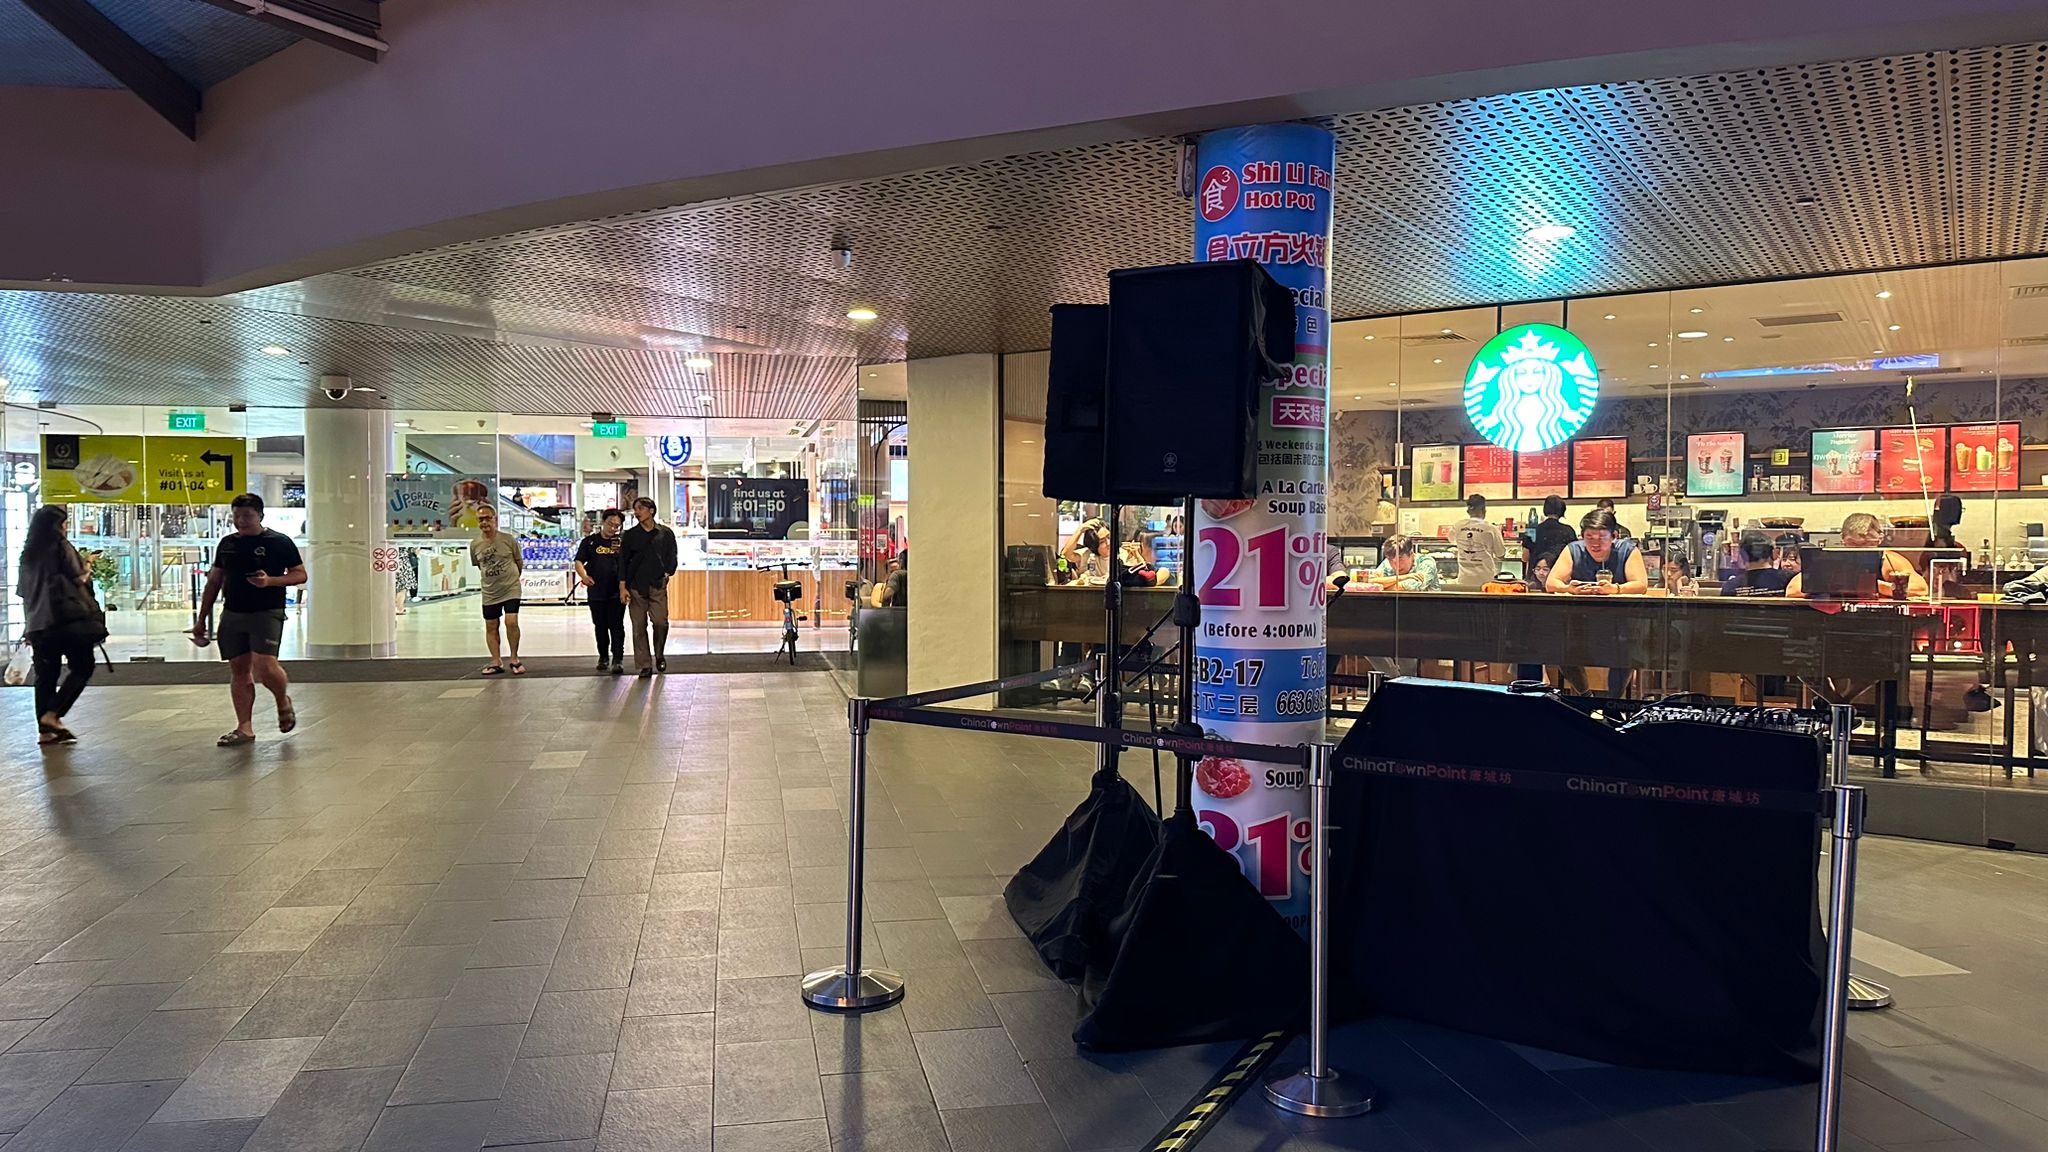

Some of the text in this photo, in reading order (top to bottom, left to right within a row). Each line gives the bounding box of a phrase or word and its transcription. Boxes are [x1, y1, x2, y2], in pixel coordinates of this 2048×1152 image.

[1243, 161, 1279, 183] Shi
[1287, 163, 1304, 183] Li
[1203, 179, 1227, 214] 食
[1246, 192, 1315, 209] Hot Pot
[176, 418, 197, 428] EXIT
[600, 426, 618, 436] EXIT
[1266, 440, 1313, 450] Weekends
[159, 469, 179, 478] Visit
[160, 480, 205, 491] #01-04
[1262, 481, 1324, 495] A La Carte
[734, 489, 785, 498] find us at
[421, 500, 439, 511] SIZE
[733, 500, 785, 512] #01-50
[1269, 501, 1305, 516] Soup
[1292, 533, 1326, 553] off
[1199, 527, 1287, 606] 21
[524, 579, 561, 588] FairPrice
[1299, 561, 1325, 606] %
[1204, 622, 1257, 638] (Before
[1262, 622, 1317, 639] 4:00PM)
[1265, 769, 1304, 788] Soup
